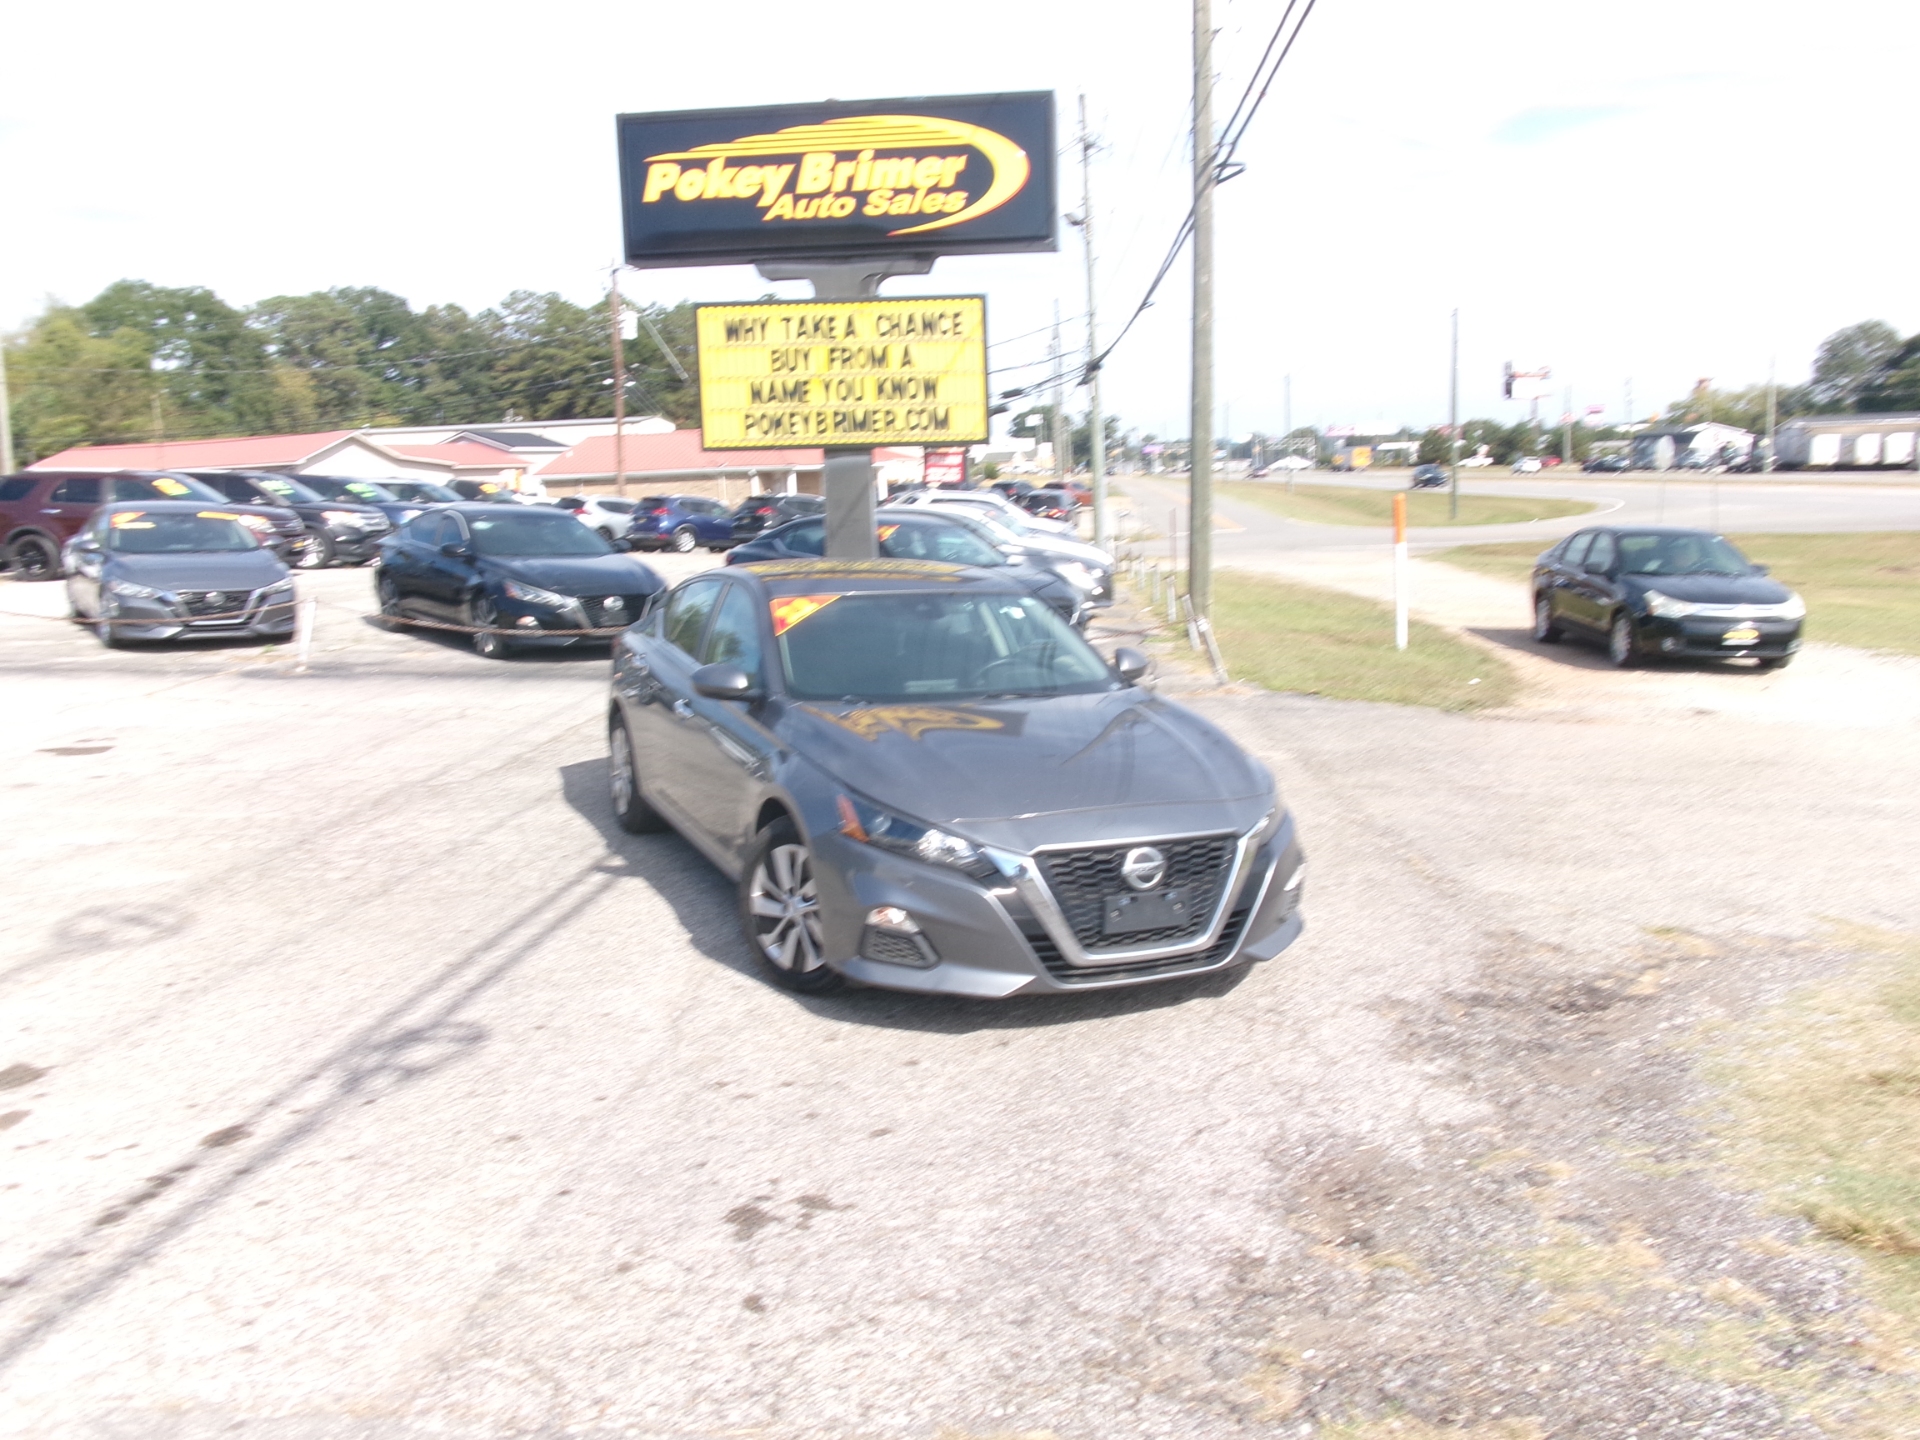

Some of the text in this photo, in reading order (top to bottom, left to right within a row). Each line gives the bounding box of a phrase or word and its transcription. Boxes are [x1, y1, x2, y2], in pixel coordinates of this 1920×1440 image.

[643, 149, 968, 207] Pokey Brimer
[762, 188, 968, 221] Auto Sales
[724, 311, 963, 342] WHY TAKE A CHANCE
[771, 343, 915, 373] BUY FROM A
[750, 375, 938, 404] NAME YOU KNOW
